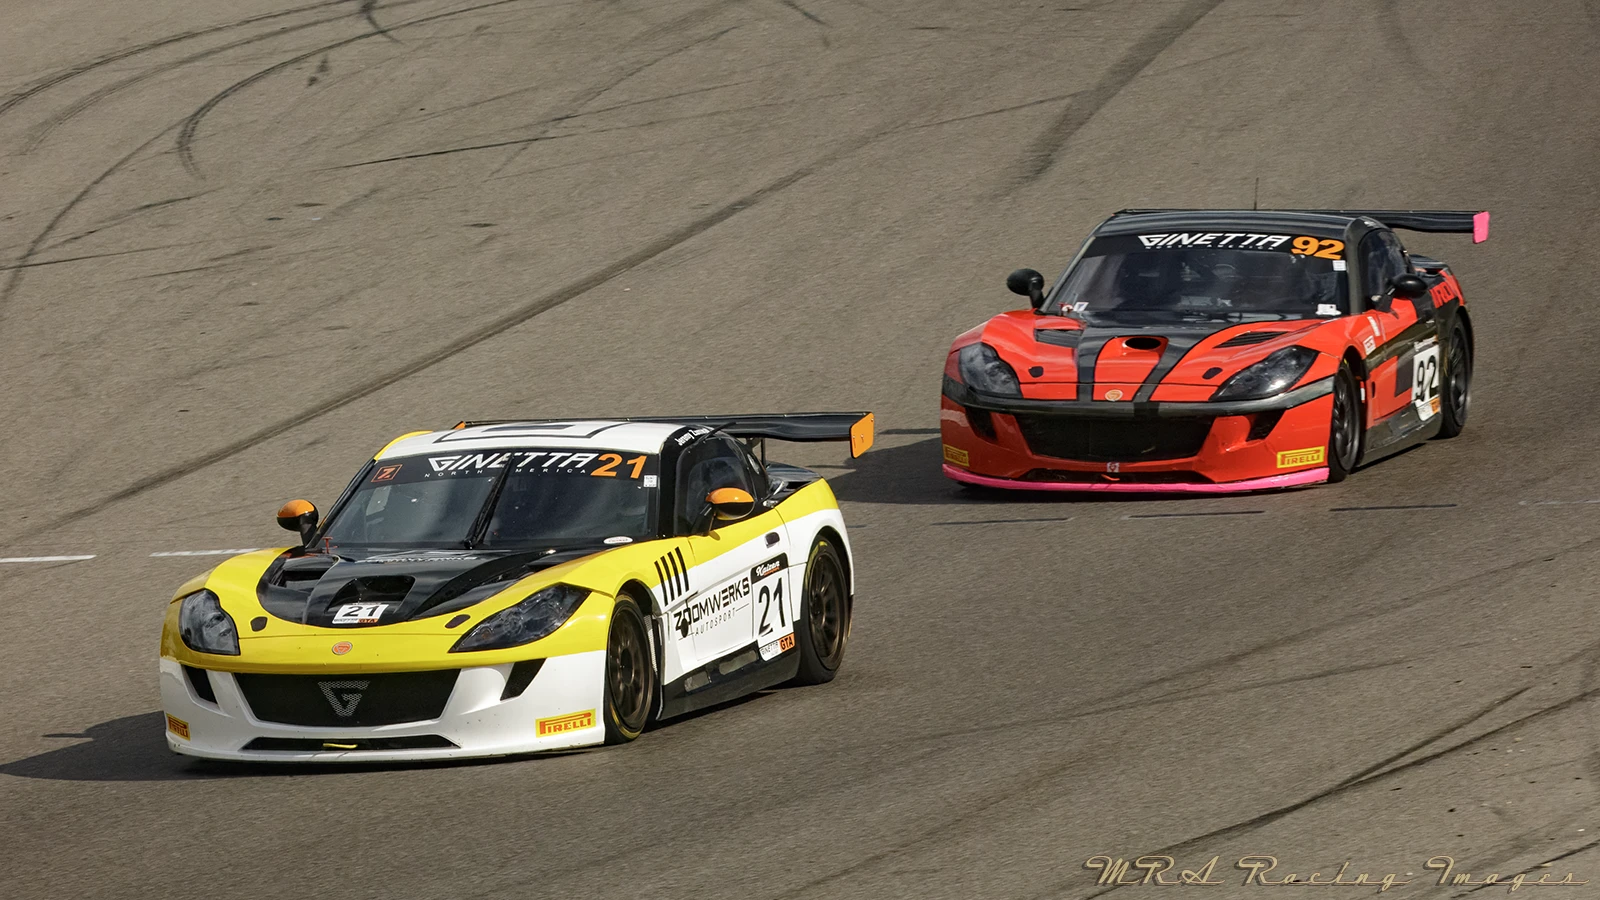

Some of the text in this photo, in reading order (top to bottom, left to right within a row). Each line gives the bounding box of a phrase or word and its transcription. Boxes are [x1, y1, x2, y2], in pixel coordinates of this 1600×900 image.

[1137, 232, 1346, 261] GINETTA 92
[1415, 354, 1440, 402] 92
[590, 453, 648, 479] 21
[1280, 449, 1321, 466] PIRELLI
[424, 469, 483, 478] NORTH
[341, 605, 380, 618] 21
[673, 576, 751, 632] ZOOMWERKS
[758, 577, 787, 637] 21
[694, 607, 736, 637] AUTOSPORT
[780, 635, 794, 651] GTA
[539, 711, 592, 735] PIRELLI
